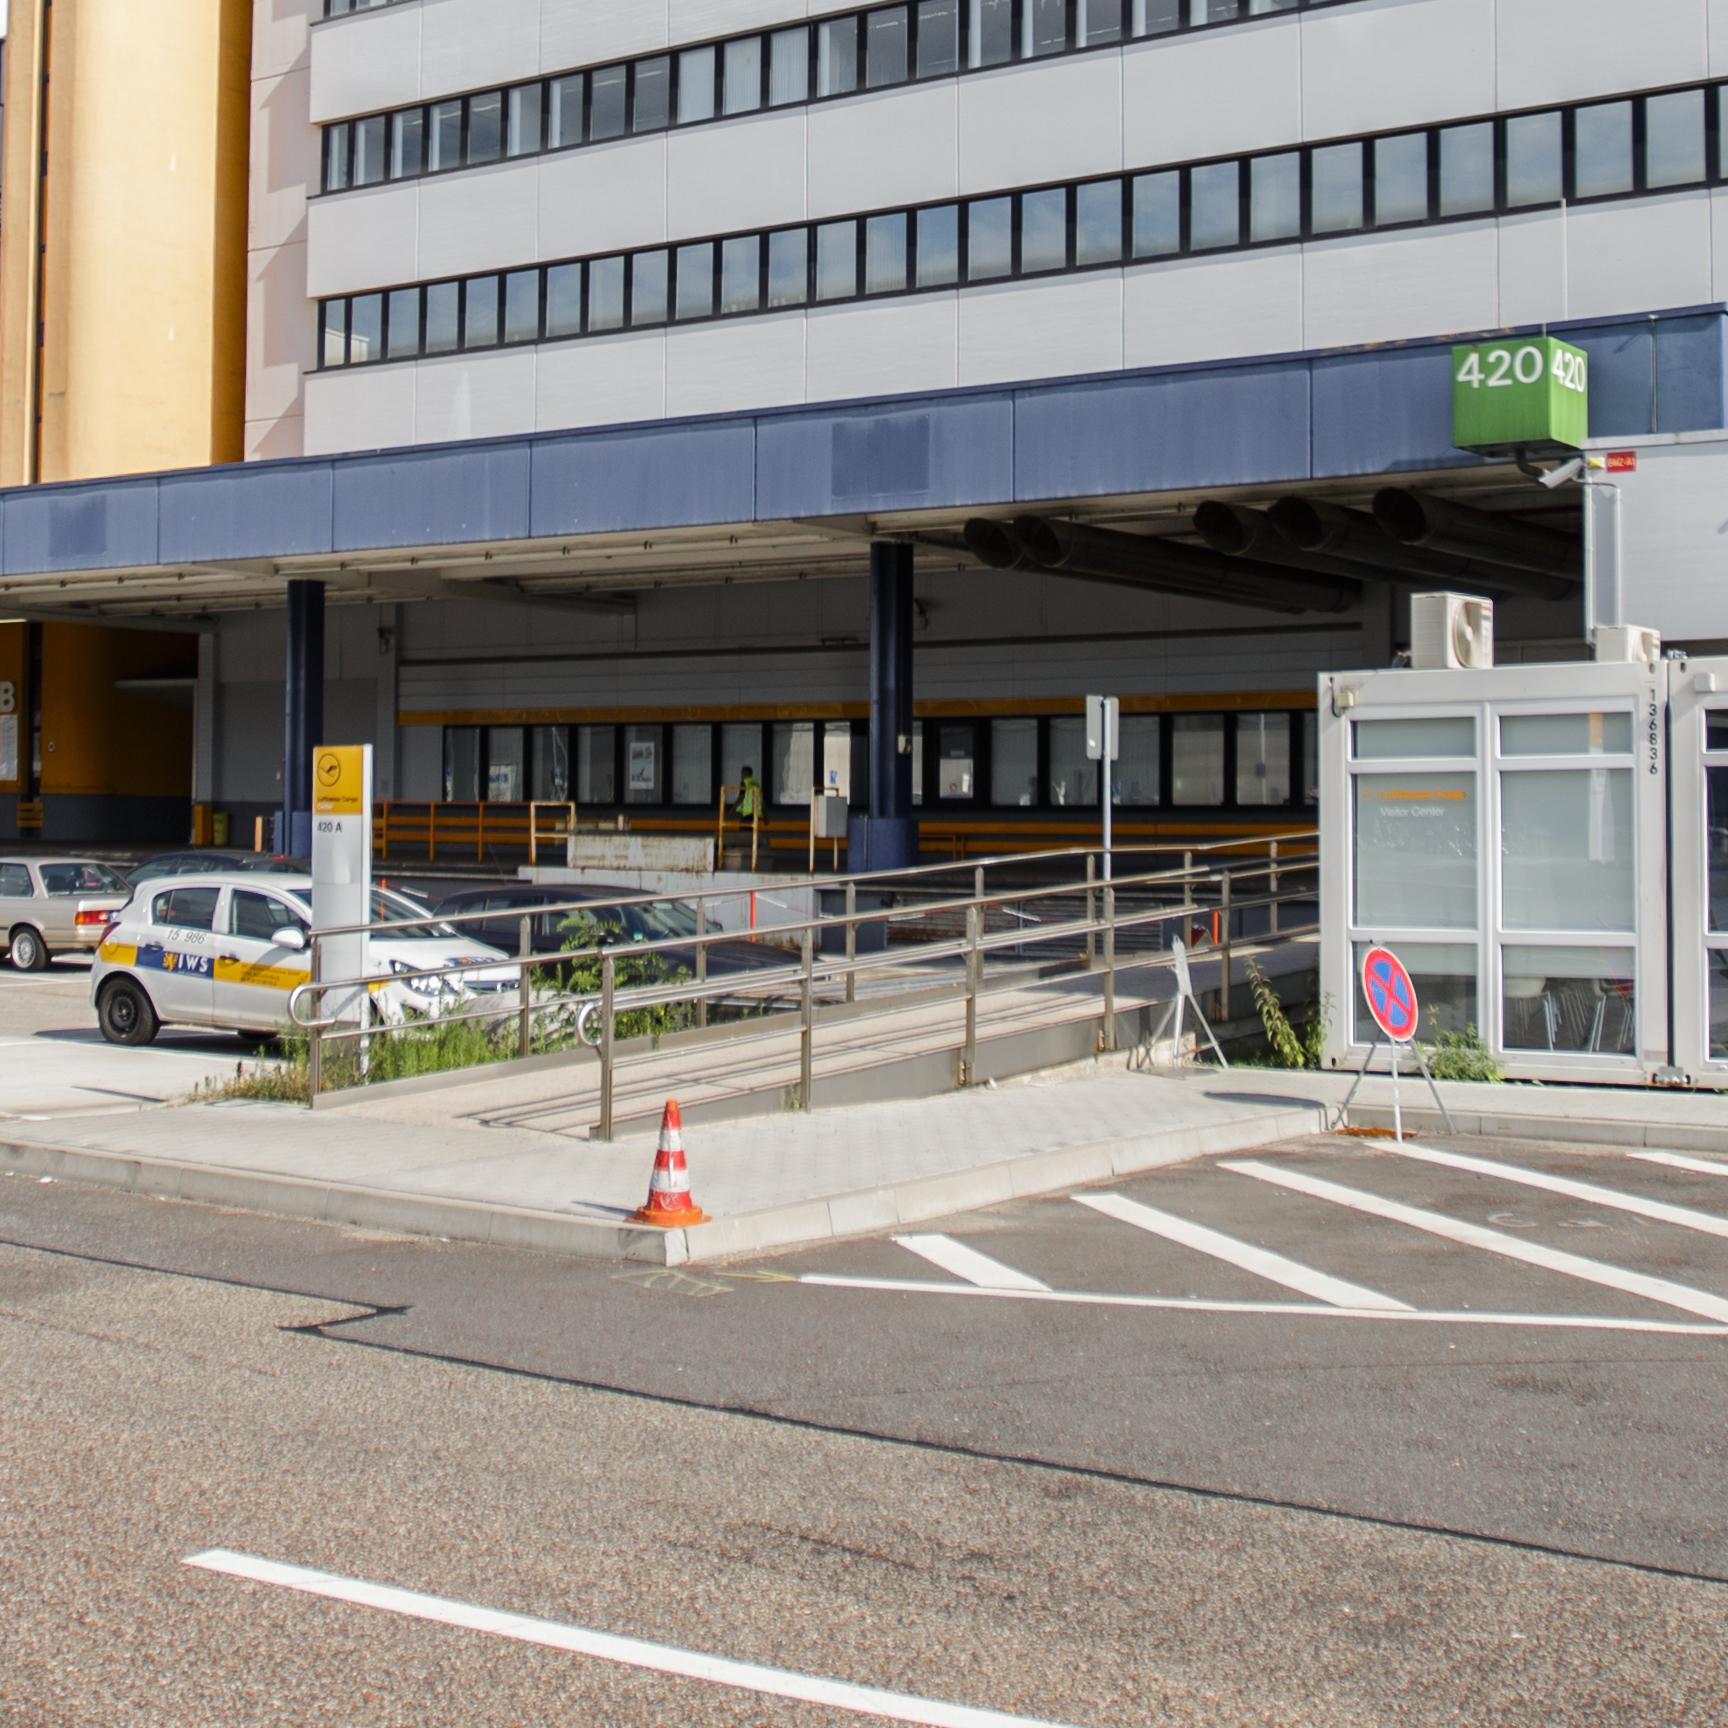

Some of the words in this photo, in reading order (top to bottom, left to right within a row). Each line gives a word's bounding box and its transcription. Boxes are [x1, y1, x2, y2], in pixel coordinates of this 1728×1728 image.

[1456, 346, 1544, 389] 420
[1551, 349, 1587, 393] 420
[0, 681, 15, 713] B
[317, 822, 333, 833] 420
[335, 822, 342, 833] A
